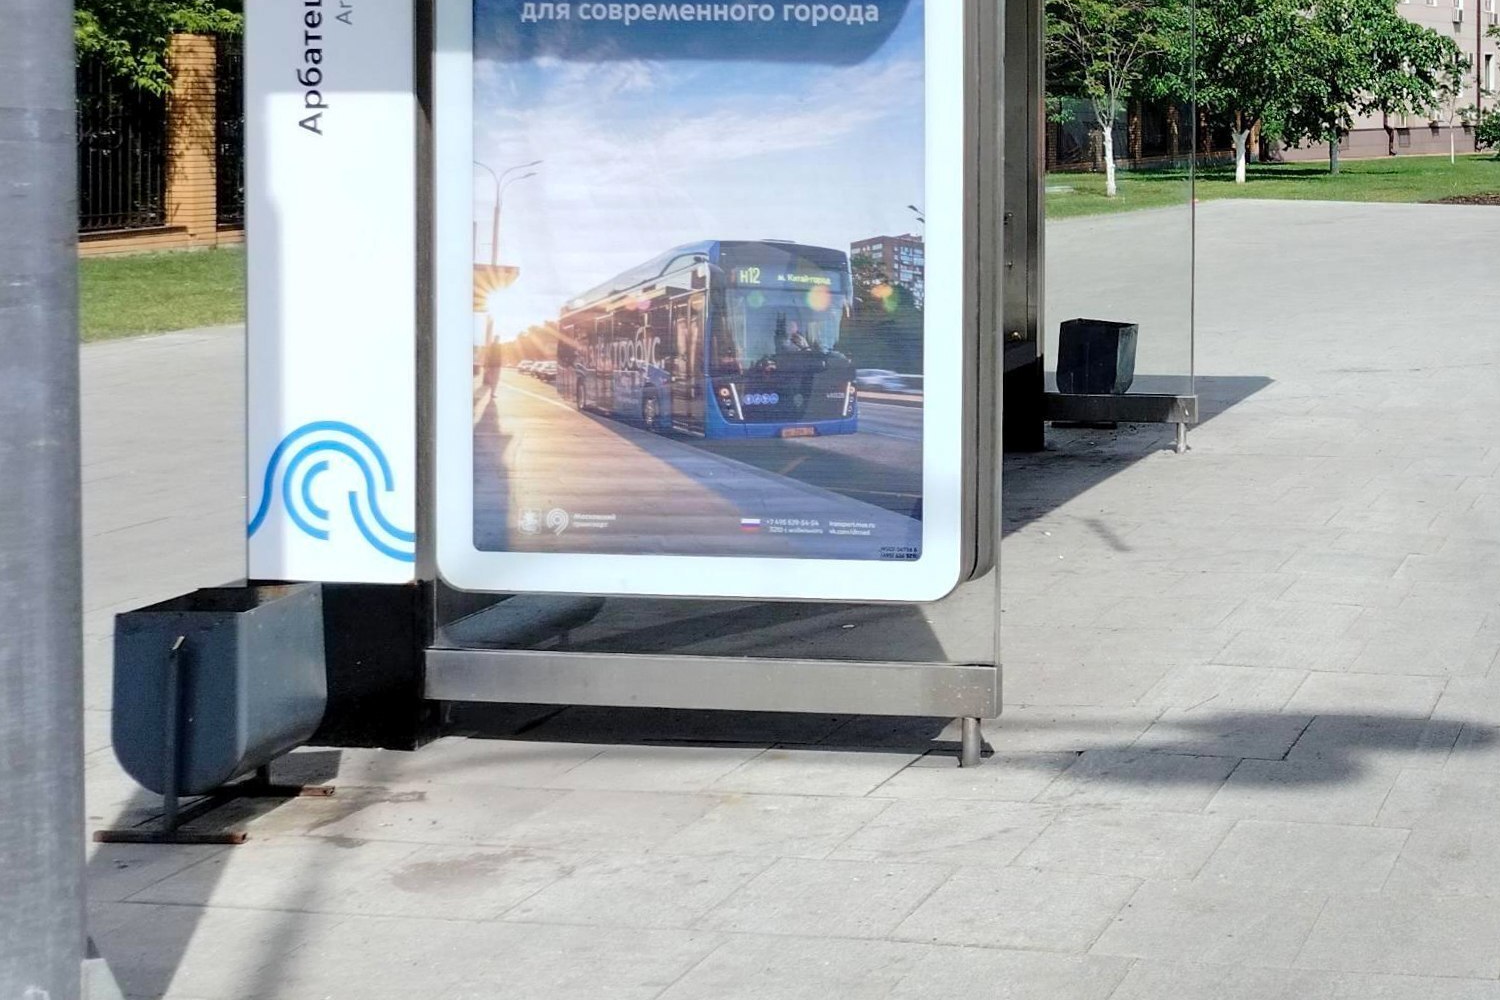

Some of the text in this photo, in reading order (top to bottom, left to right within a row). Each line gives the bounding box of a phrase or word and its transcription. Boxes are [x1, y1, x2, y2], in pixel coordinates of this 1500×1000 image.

[521, 2, 879, 27] для современного города
